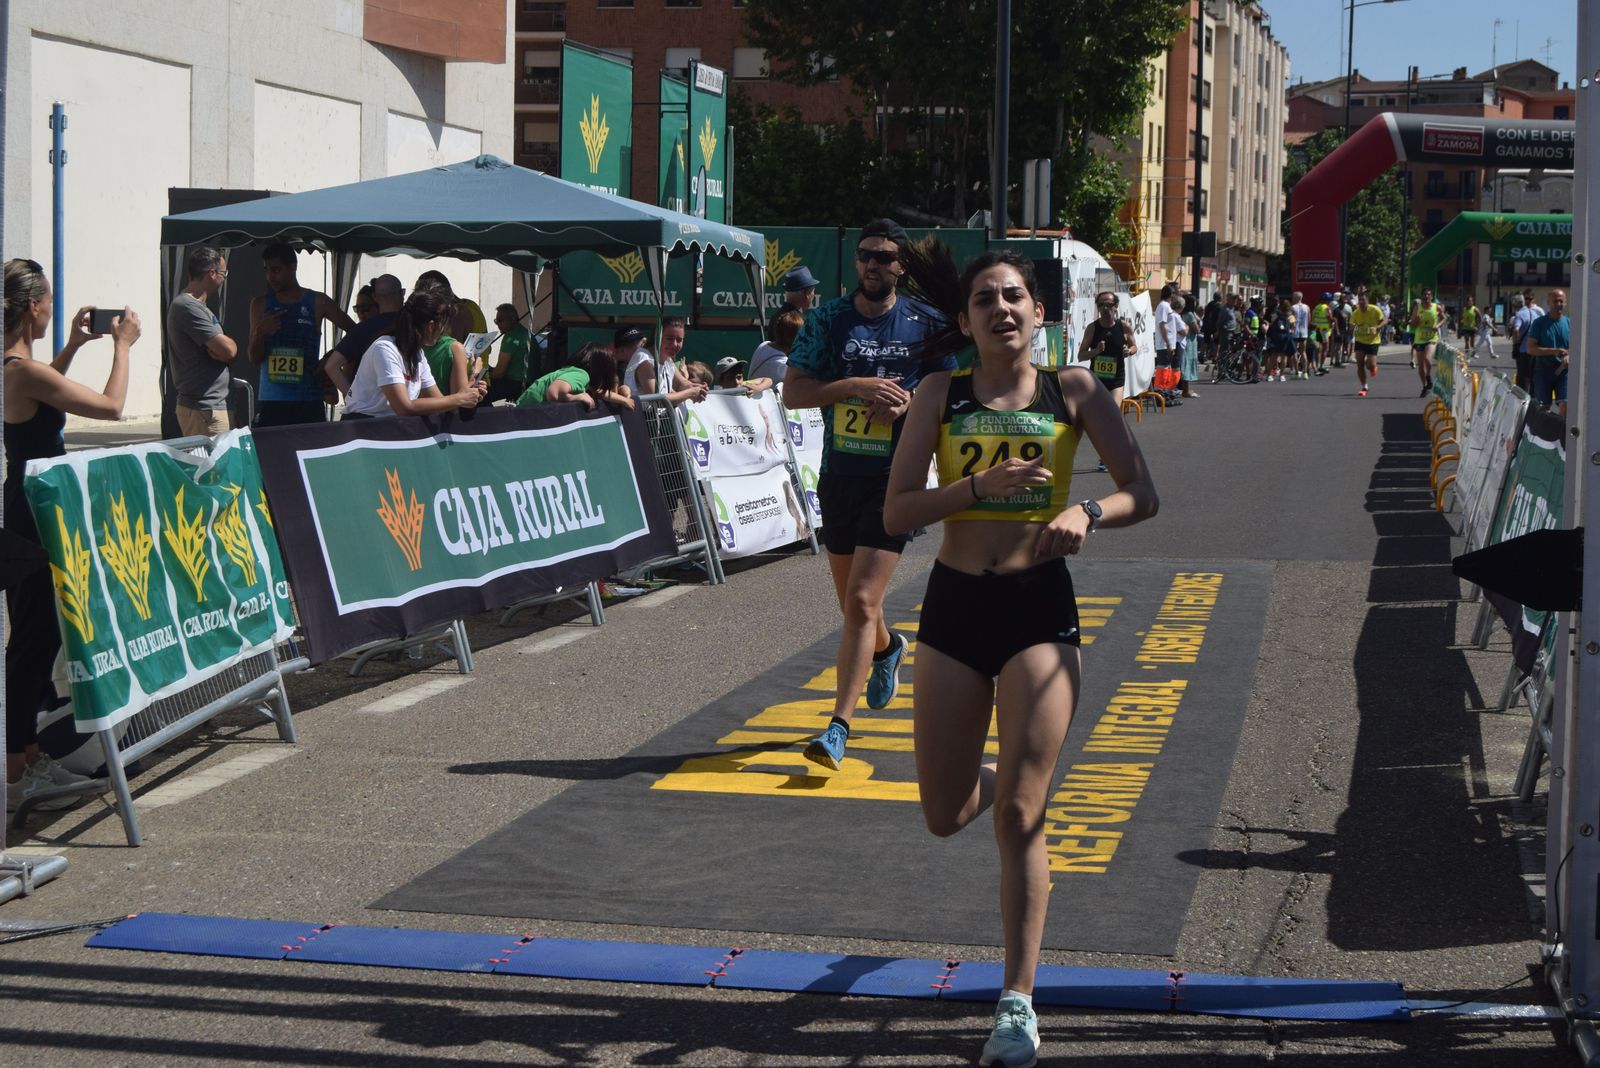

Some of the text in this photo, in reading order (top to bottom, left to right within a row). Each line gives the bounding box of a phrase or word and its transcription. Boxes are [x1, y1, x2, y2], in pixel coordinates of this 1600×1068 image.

[1496, 128, 1527, 140] CON
[1531, 130, 1547, 141] EL
[1437, 140, 1480, 150] ZAMORA
[1496, 145, 1564, 158] GANAMOS
[1516, 221, 1554, 236] CAJA
[572, 288, 614, 305] CAJA
[712, 291, 757, 308] CAJA
[271, 357, 298, 373] 128
[1096, 362, 1113, 372] 163
[845, 408, 874, 435] 27
[980, 425, 1041, 434] CAJA RURAL
[433, 469, 605, 556] CAJA RURAL
[1155, 572, 1224, 621] INTERIORES
[1082, 679, 1189, 754] INTEGRAL
[1044, 762, 1155, 874] REFORMA
